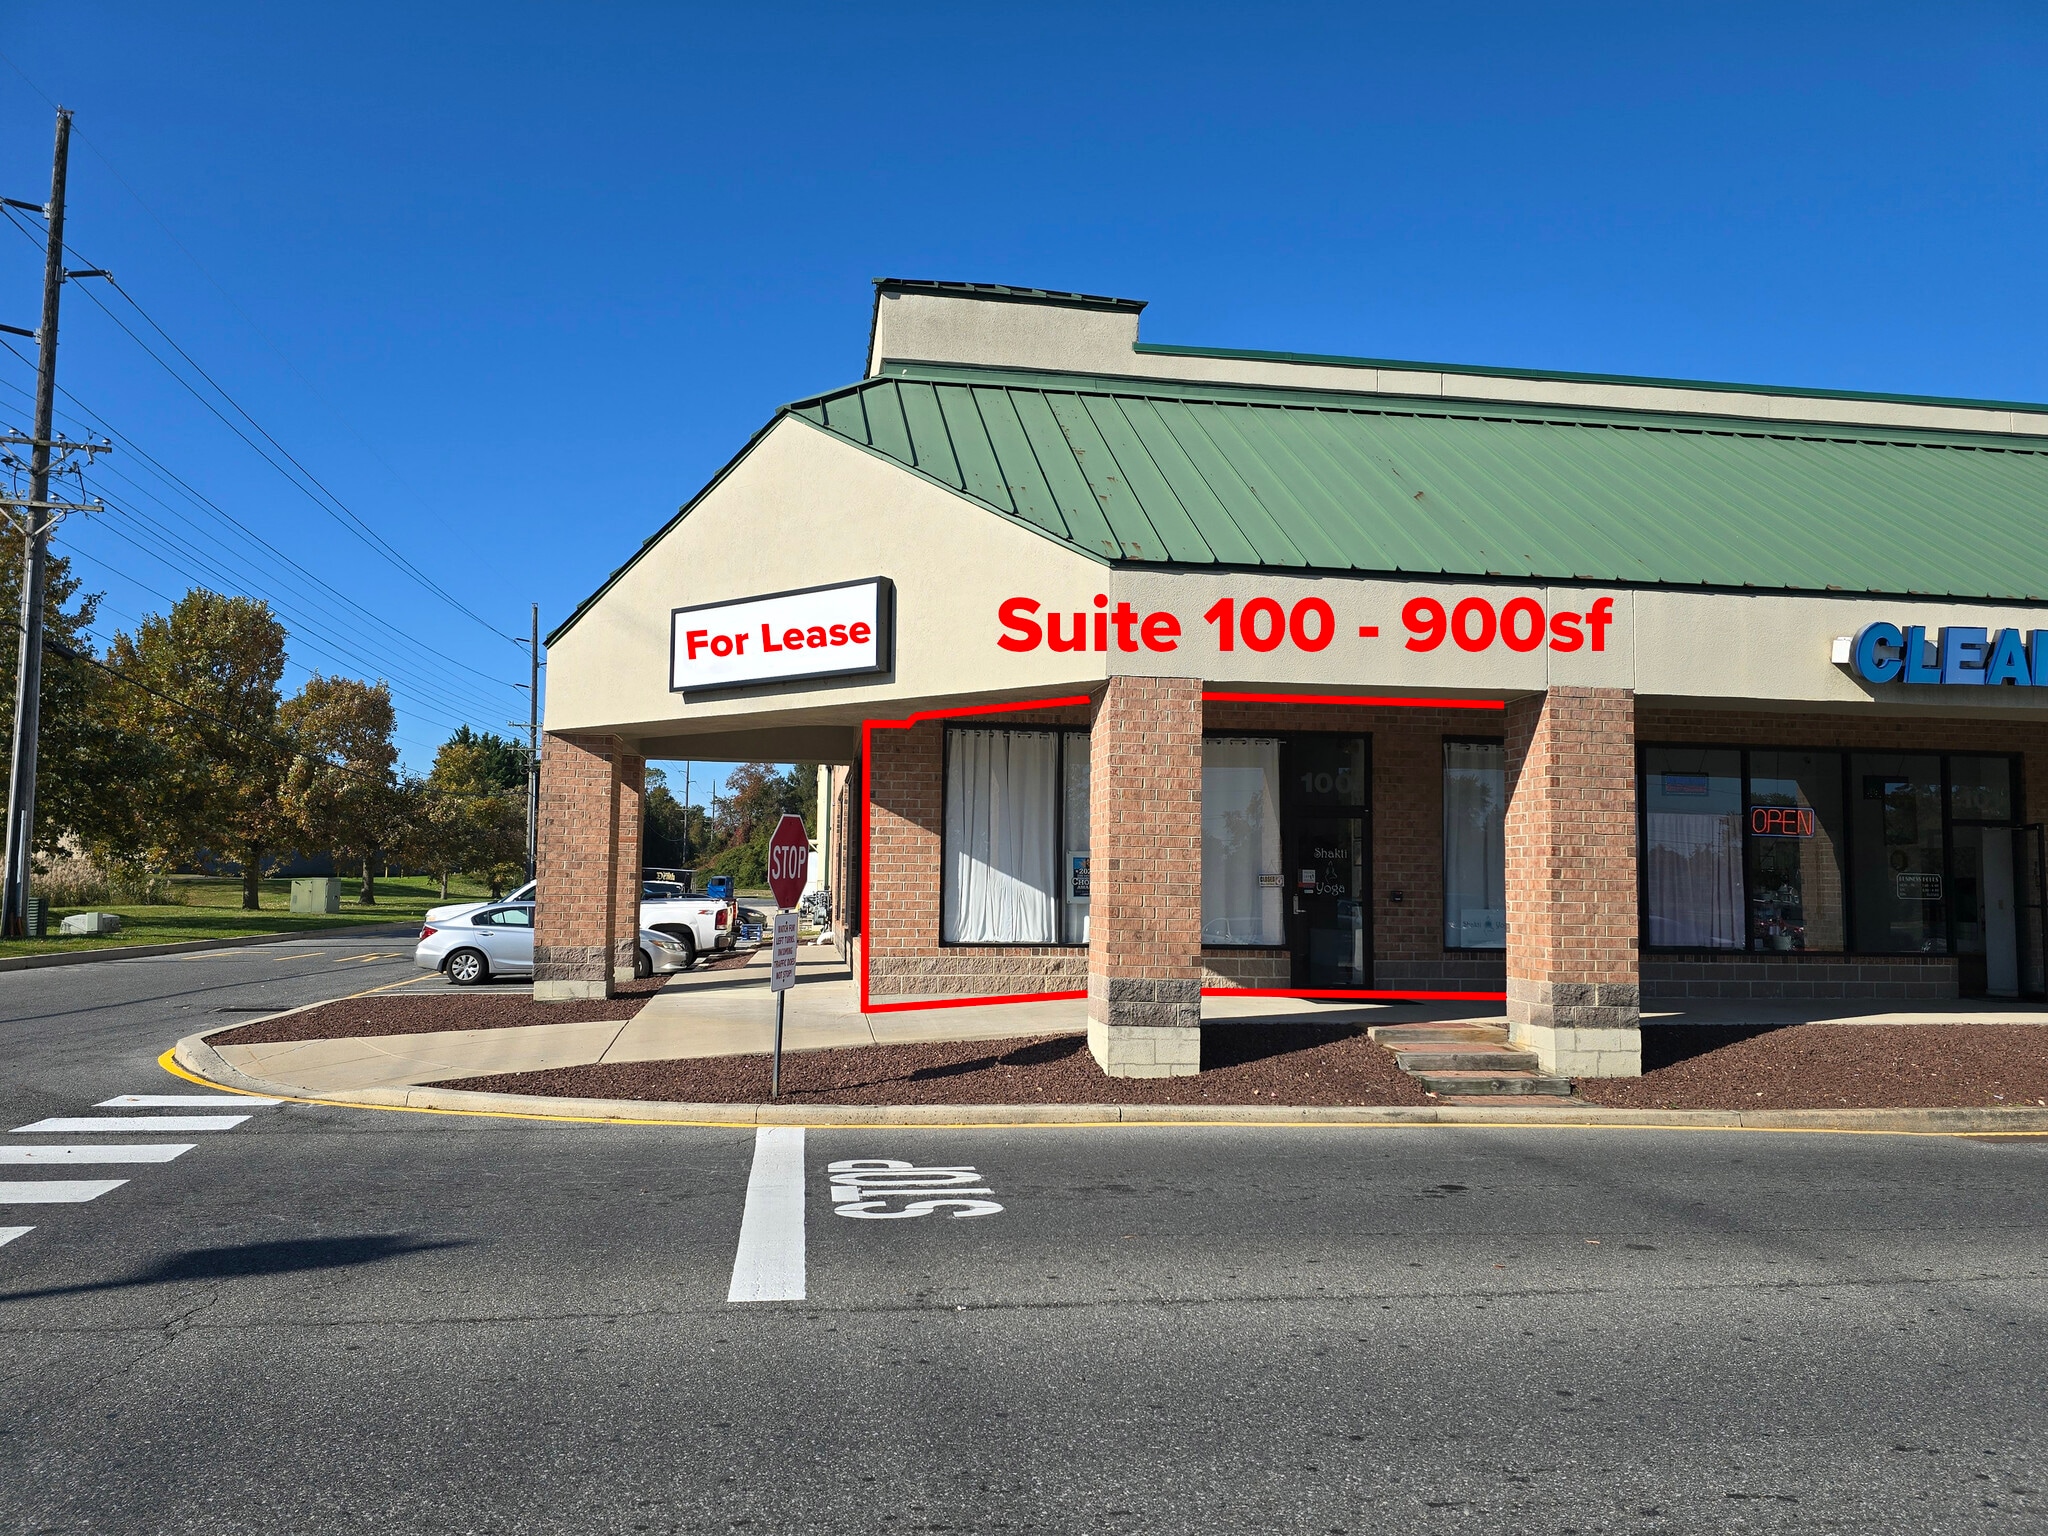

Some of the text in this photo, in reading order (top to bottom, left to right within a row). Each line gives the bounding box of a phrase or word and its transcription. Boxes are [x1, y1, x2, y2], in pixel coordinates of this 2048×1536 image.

[1300, 772, 1352, 794] 100
[1752, 809, 1812, 835] OPEN
[771, 845, 806, 880] STOP
[1316, 882, 1345, 896] Yoga
[776, 937, 784, 945] LEFT
[828, 1159, 1004, 1219] STOP
